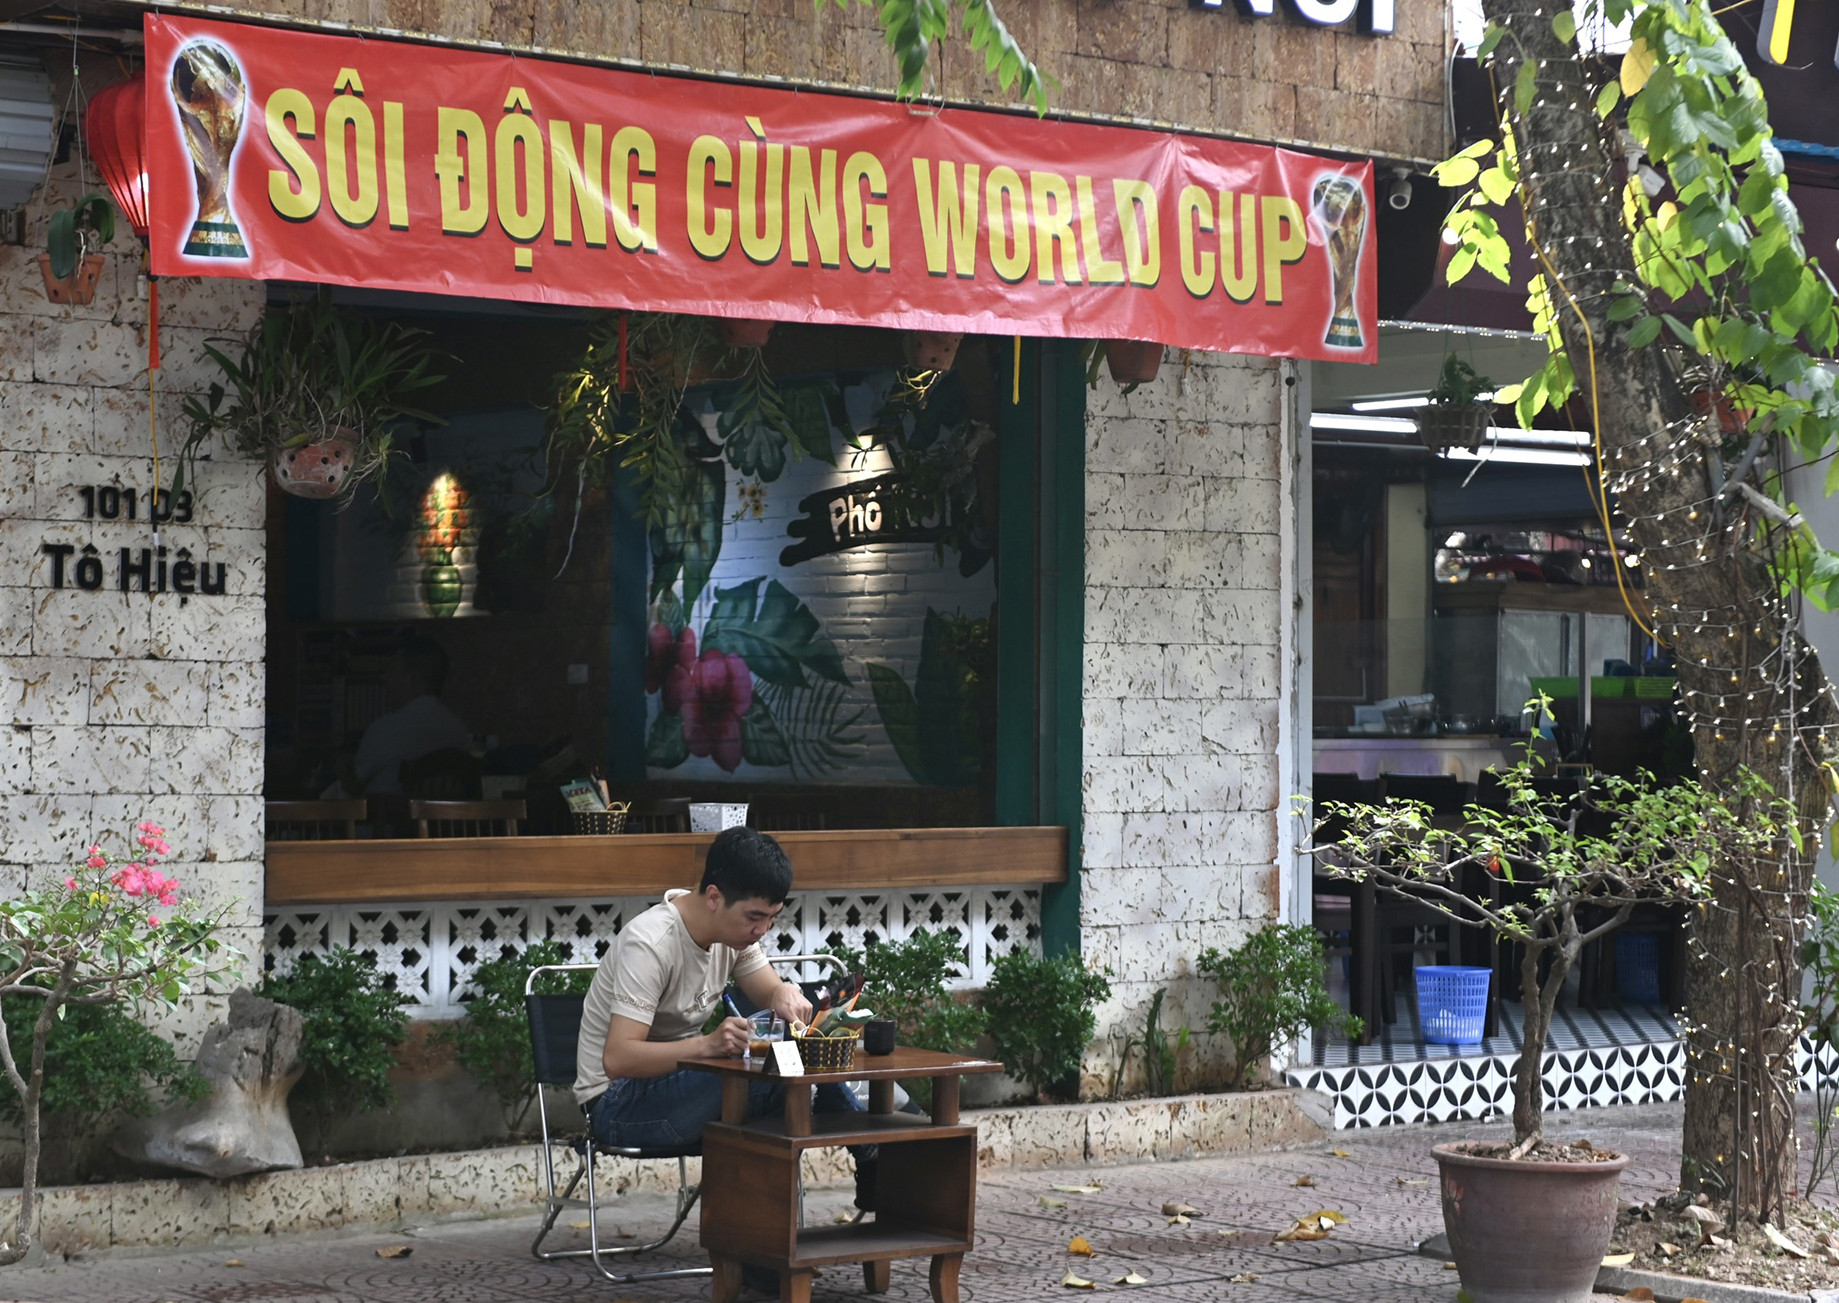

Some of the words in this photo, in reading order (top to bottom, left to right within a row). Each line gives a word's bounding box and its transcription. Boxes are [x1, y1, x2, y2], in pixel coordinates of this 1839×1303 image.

[265, 68, 409, 231] SÔI
[434, 87, 657, 273] ĐỘNG
[686, 116, 891, 273] CÙNG
[912, 157, 1162, 290] WORLD
[1178, 185, 1308, 306] CUP
[80, 485, 136, 520] 101
[150, 486, 194, 523] D3
[42, 543, 103, 590] Tô
[119, 545, 226, 608] Hiệu
